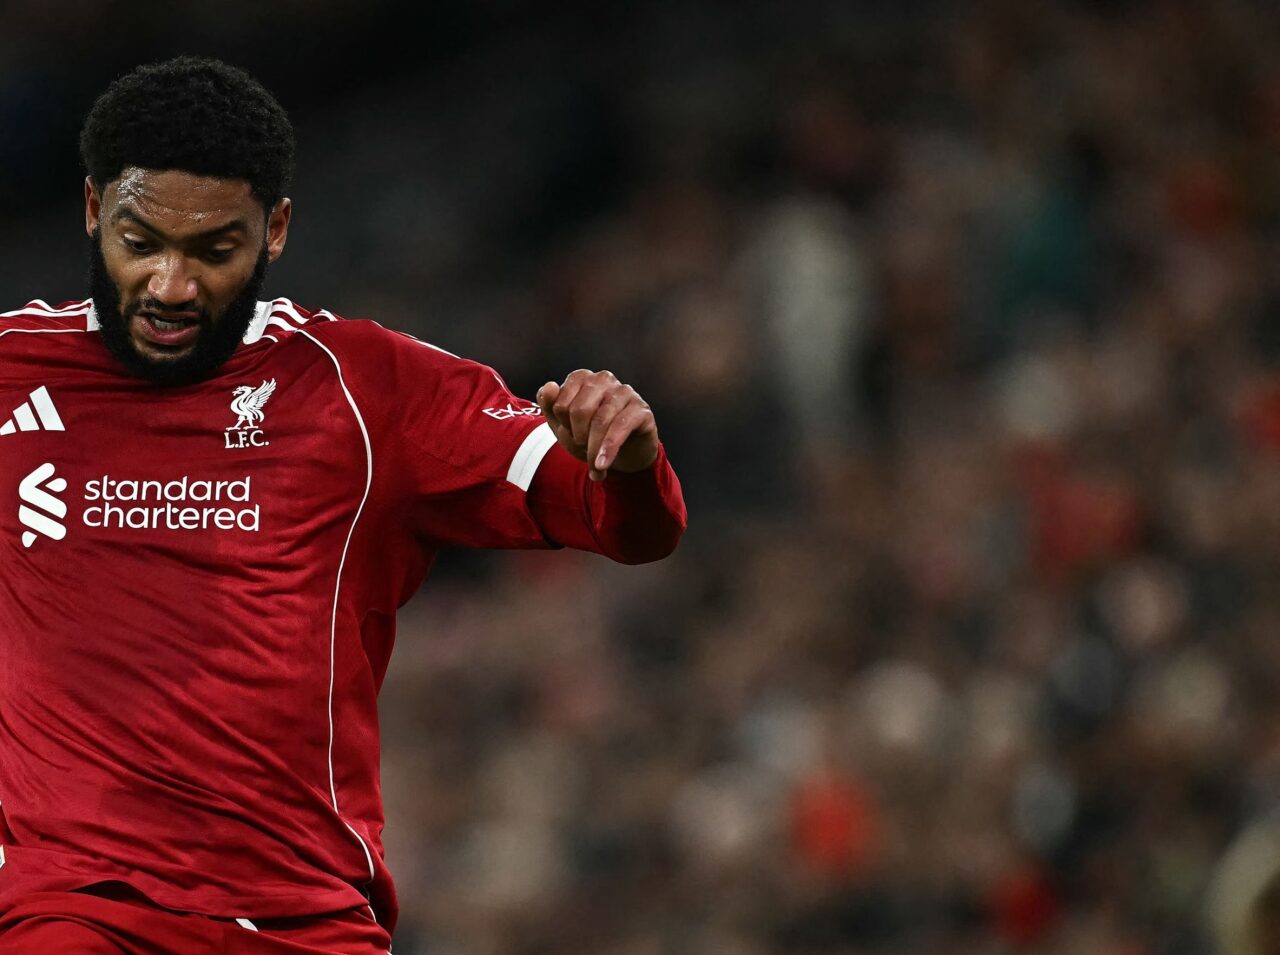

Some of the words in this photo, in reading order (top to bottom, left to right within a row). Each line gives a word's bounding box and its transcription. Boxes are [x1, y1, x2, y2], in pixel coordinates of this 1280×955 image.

[224, 429, 270, 449] L.F.C.
[84, 475, 251, 502] standard
[82, 501, 260, 532] chartered
